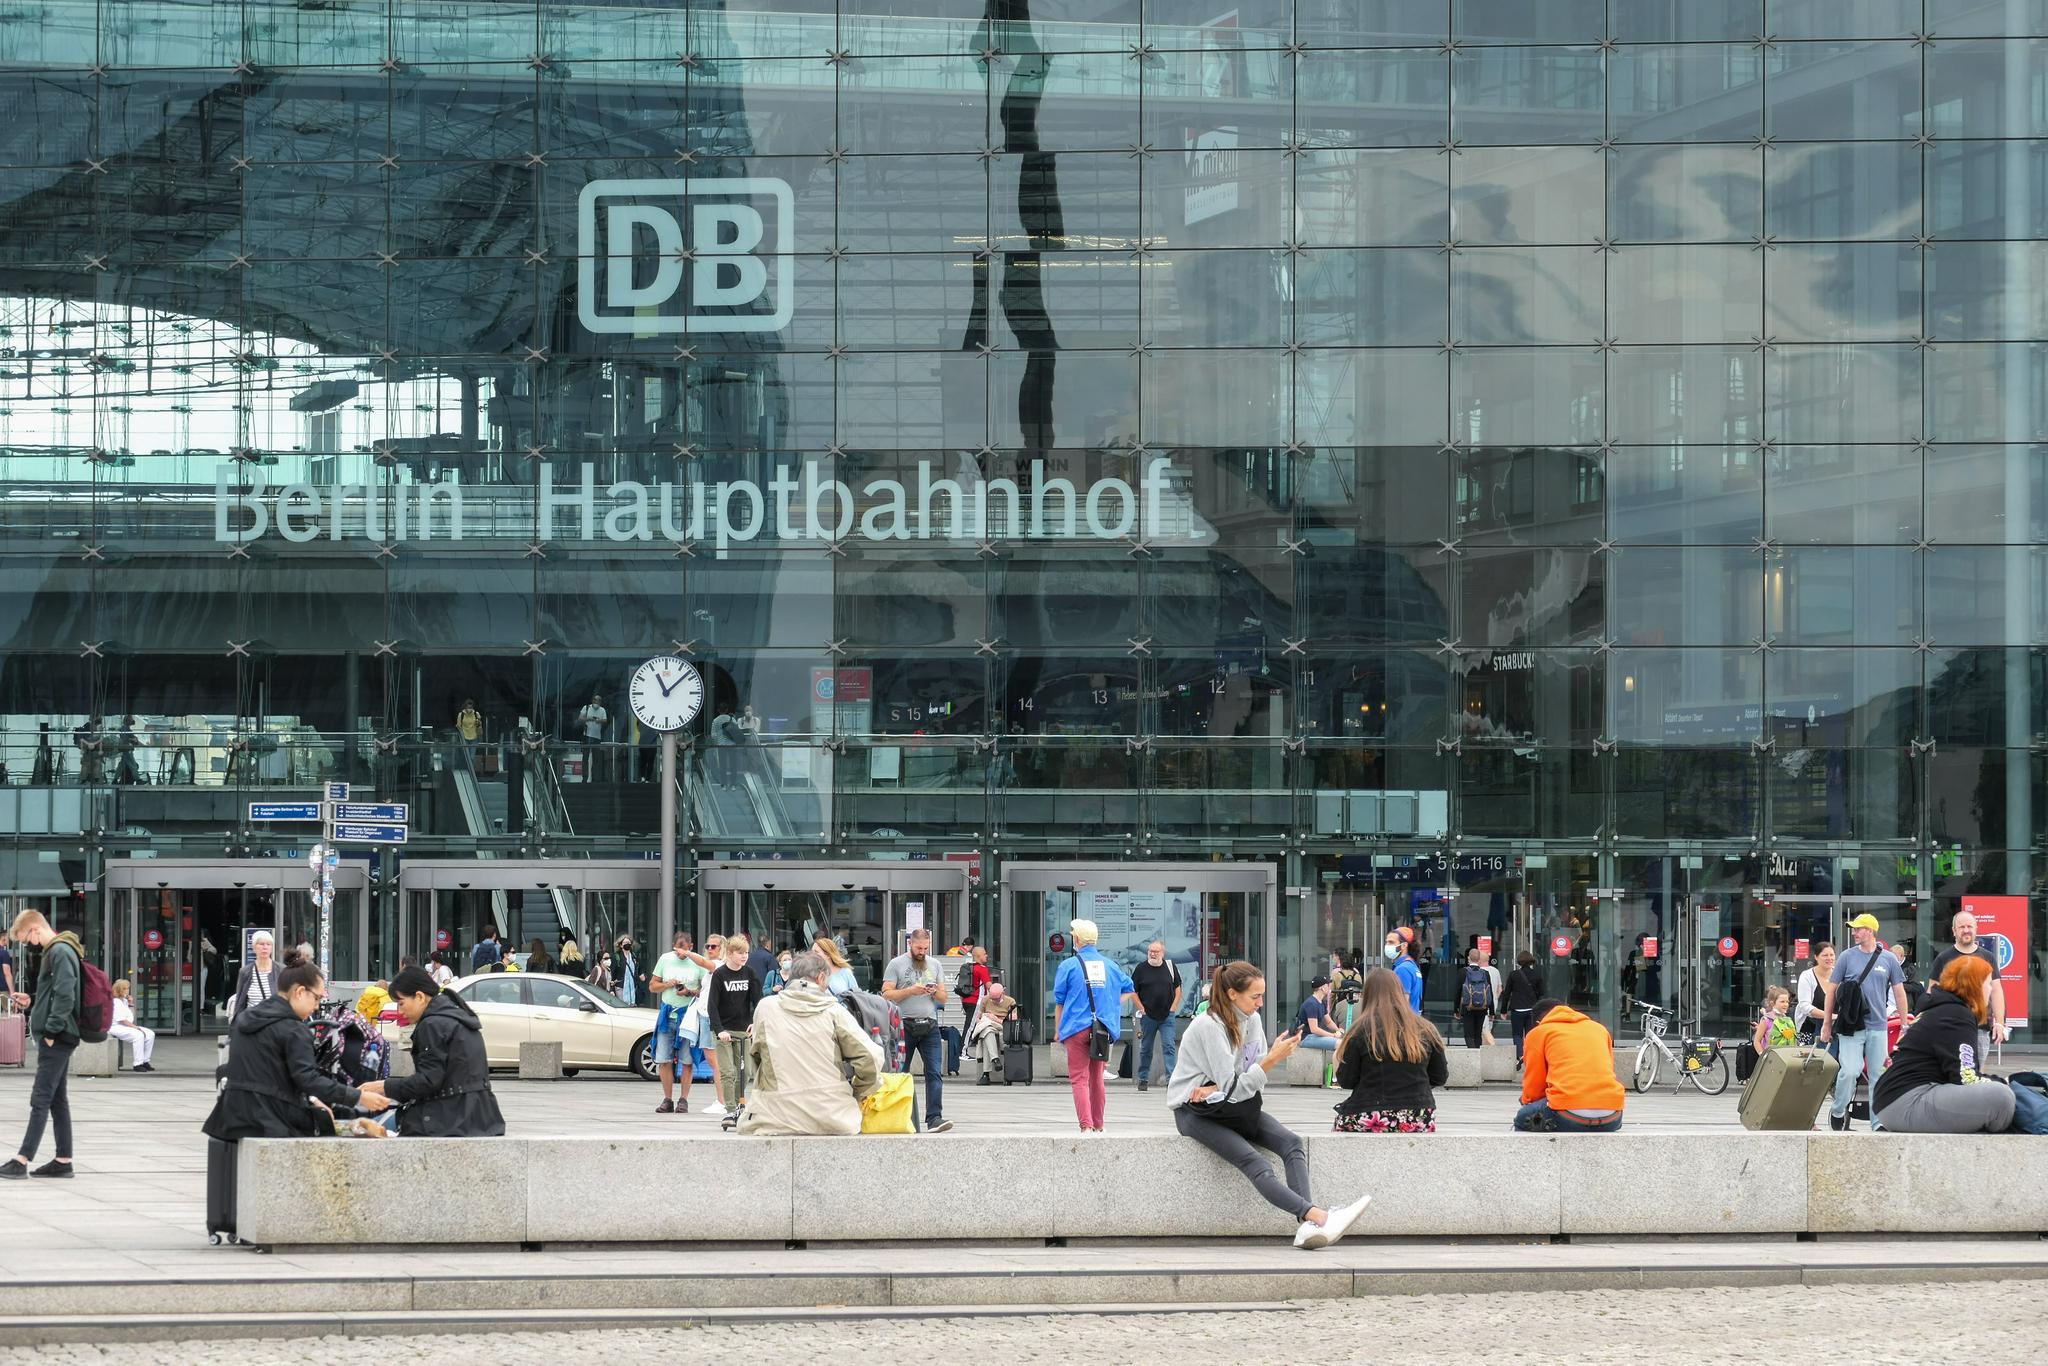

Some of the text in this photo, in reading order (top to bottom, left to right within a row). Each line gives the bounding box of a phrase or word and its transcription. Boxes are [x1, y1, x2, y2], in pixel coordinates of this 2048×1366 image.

[607, 203, 768, 307] DB
[215, 457, 1172, 558] Berlin Hauptbahnhof
[1208, 679, 1226, 694] 12
[1092, 689, 1108, 704] 13
[1018, 697, 1034, 711] 14
[891, 709, 900, 721] S
[907, 707, 921, 721] 15
[1471, 856, 1502, 870] 11-16
[724, 980, 750, 992] VANS
